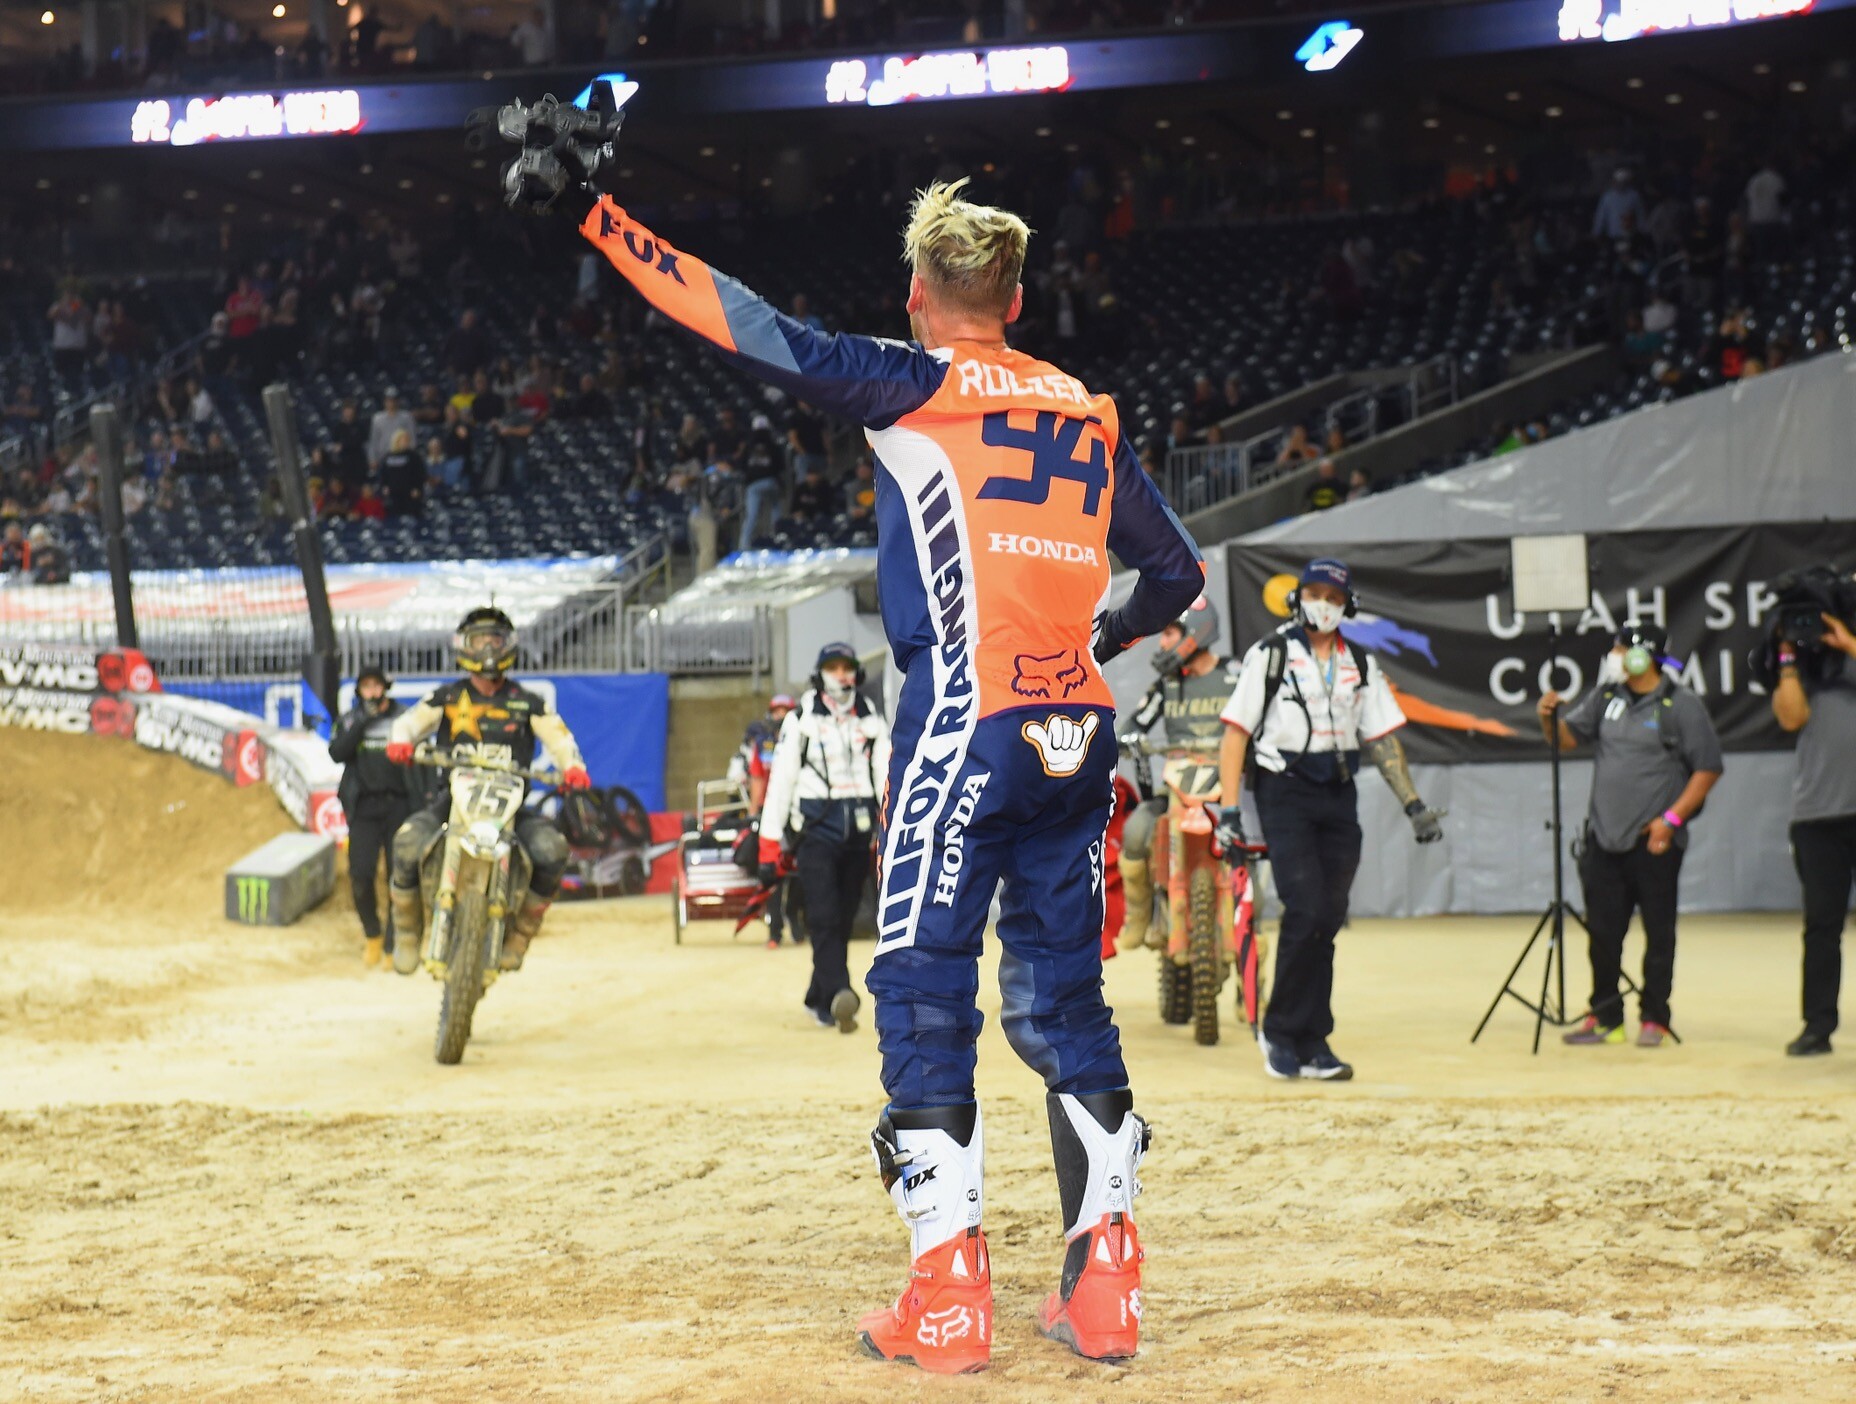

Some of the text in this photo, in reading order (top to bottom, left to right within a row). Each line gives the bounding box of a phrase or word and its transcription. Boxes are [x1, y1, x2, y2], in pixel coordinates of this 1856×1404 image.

[975, 408, 1109, 517] 94
[987, 532, 1099, 567] HONDA
[1486, 585, 1666, 640] UAH
[894, 747, 958, 858] FOX
[933, 771, 991, 908] HONDA
[904, 1164, 940, 1192] OX
